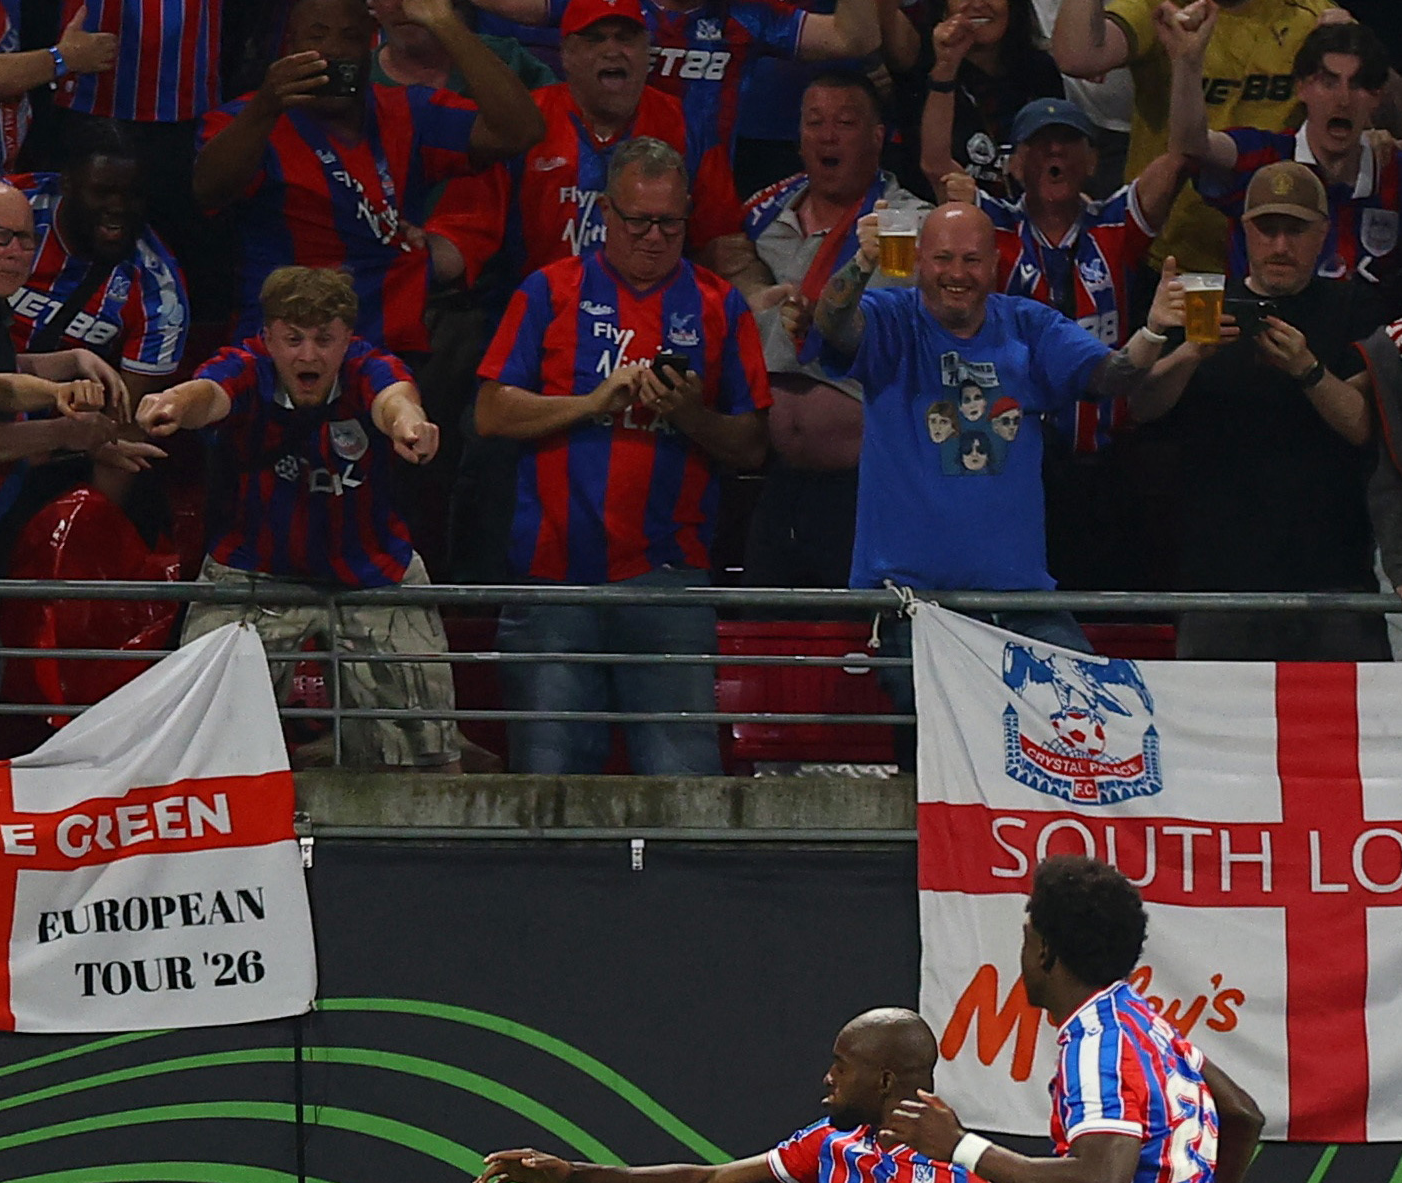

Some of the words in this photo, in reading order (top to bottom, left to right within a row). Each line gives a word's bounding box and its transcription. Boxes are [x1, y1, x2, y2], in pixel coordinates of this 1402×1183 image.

[593, 321, 627, 345] Fly
[1026, 747, 1087, 775] CRYSTAL
[992, 816, 1274, 894] SOUTH
[37, 887, 267, 945] EUROPEAN
[74, 954, 197, 998] TOUR
[203, 949, 266, 987] '26
[939, 963, 1246, 1081] Mey's
